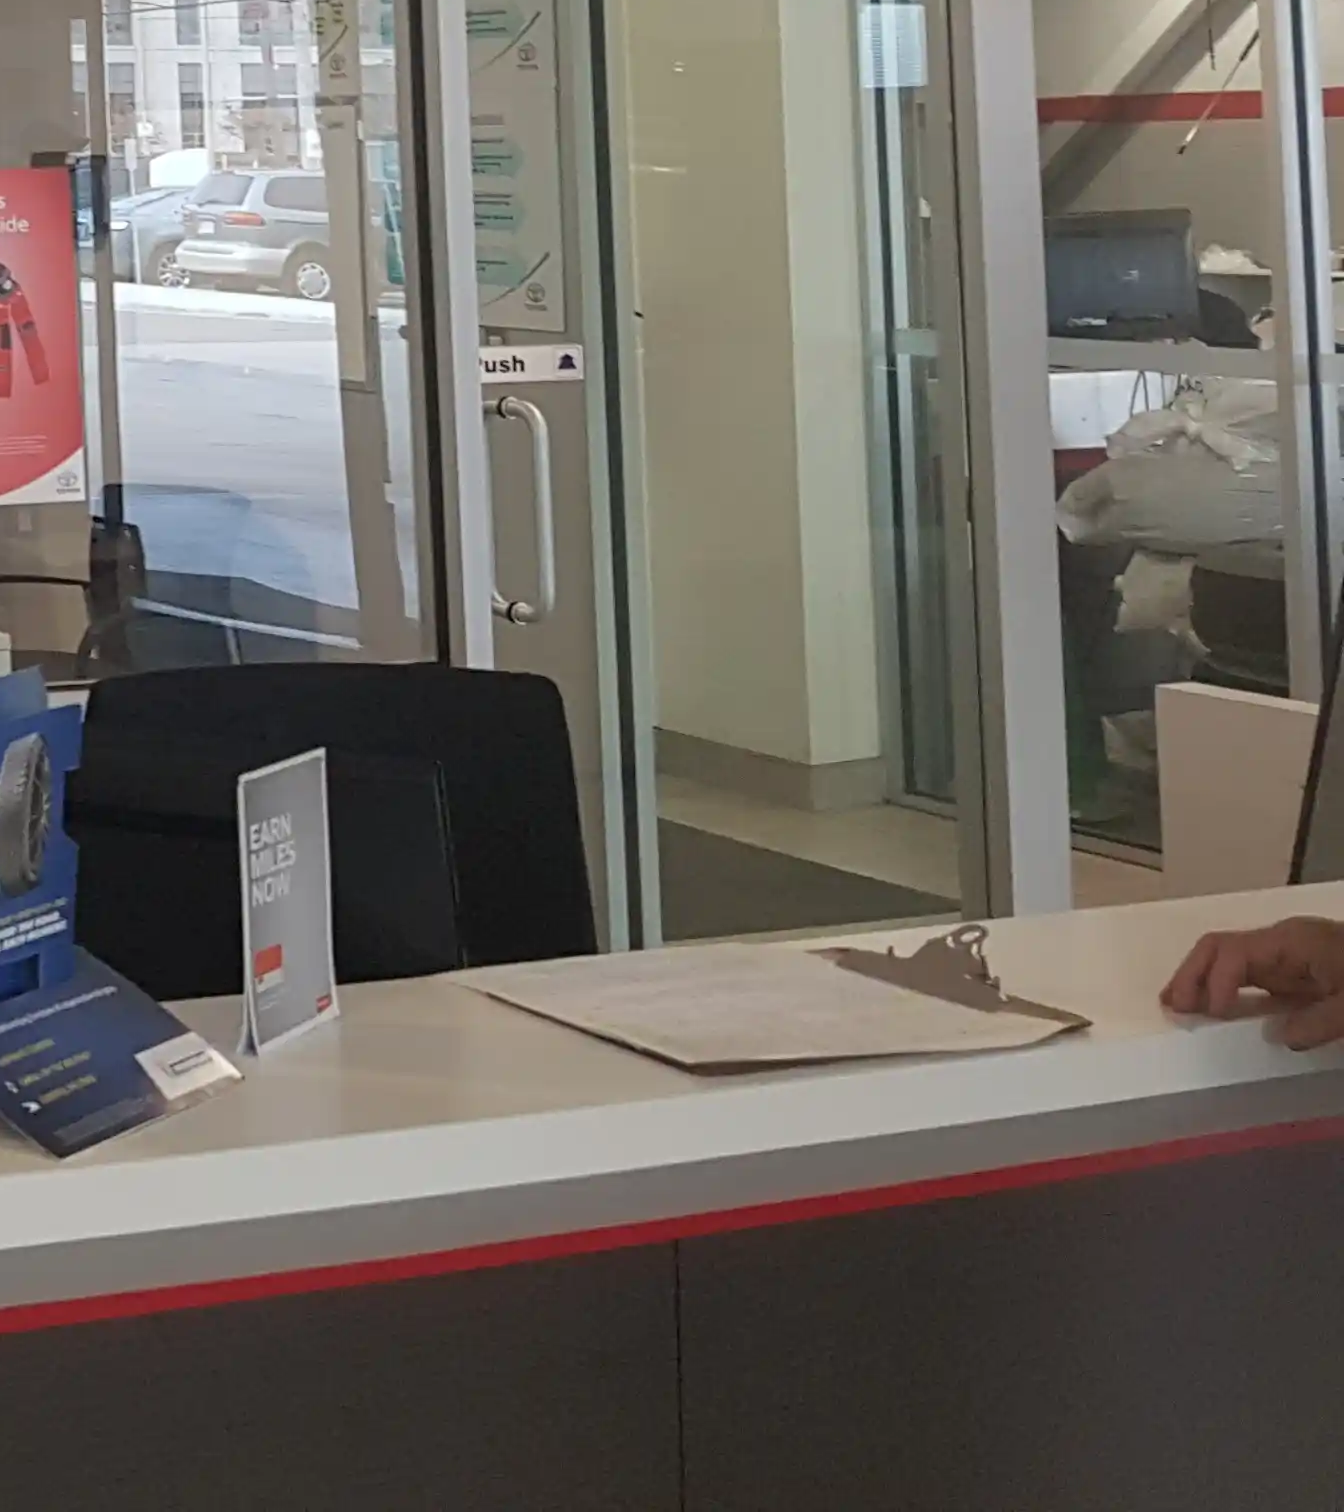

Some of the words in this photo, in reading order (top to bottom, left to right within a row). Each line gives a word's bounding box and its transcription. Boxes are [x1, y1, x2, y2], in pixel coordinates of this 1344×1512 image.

[479, 355, 525, 374] ush
[249, 812, 292, 852] EARN
[250, 840, 297, 880] MILES
[251, 872, 291, 909] NOW
